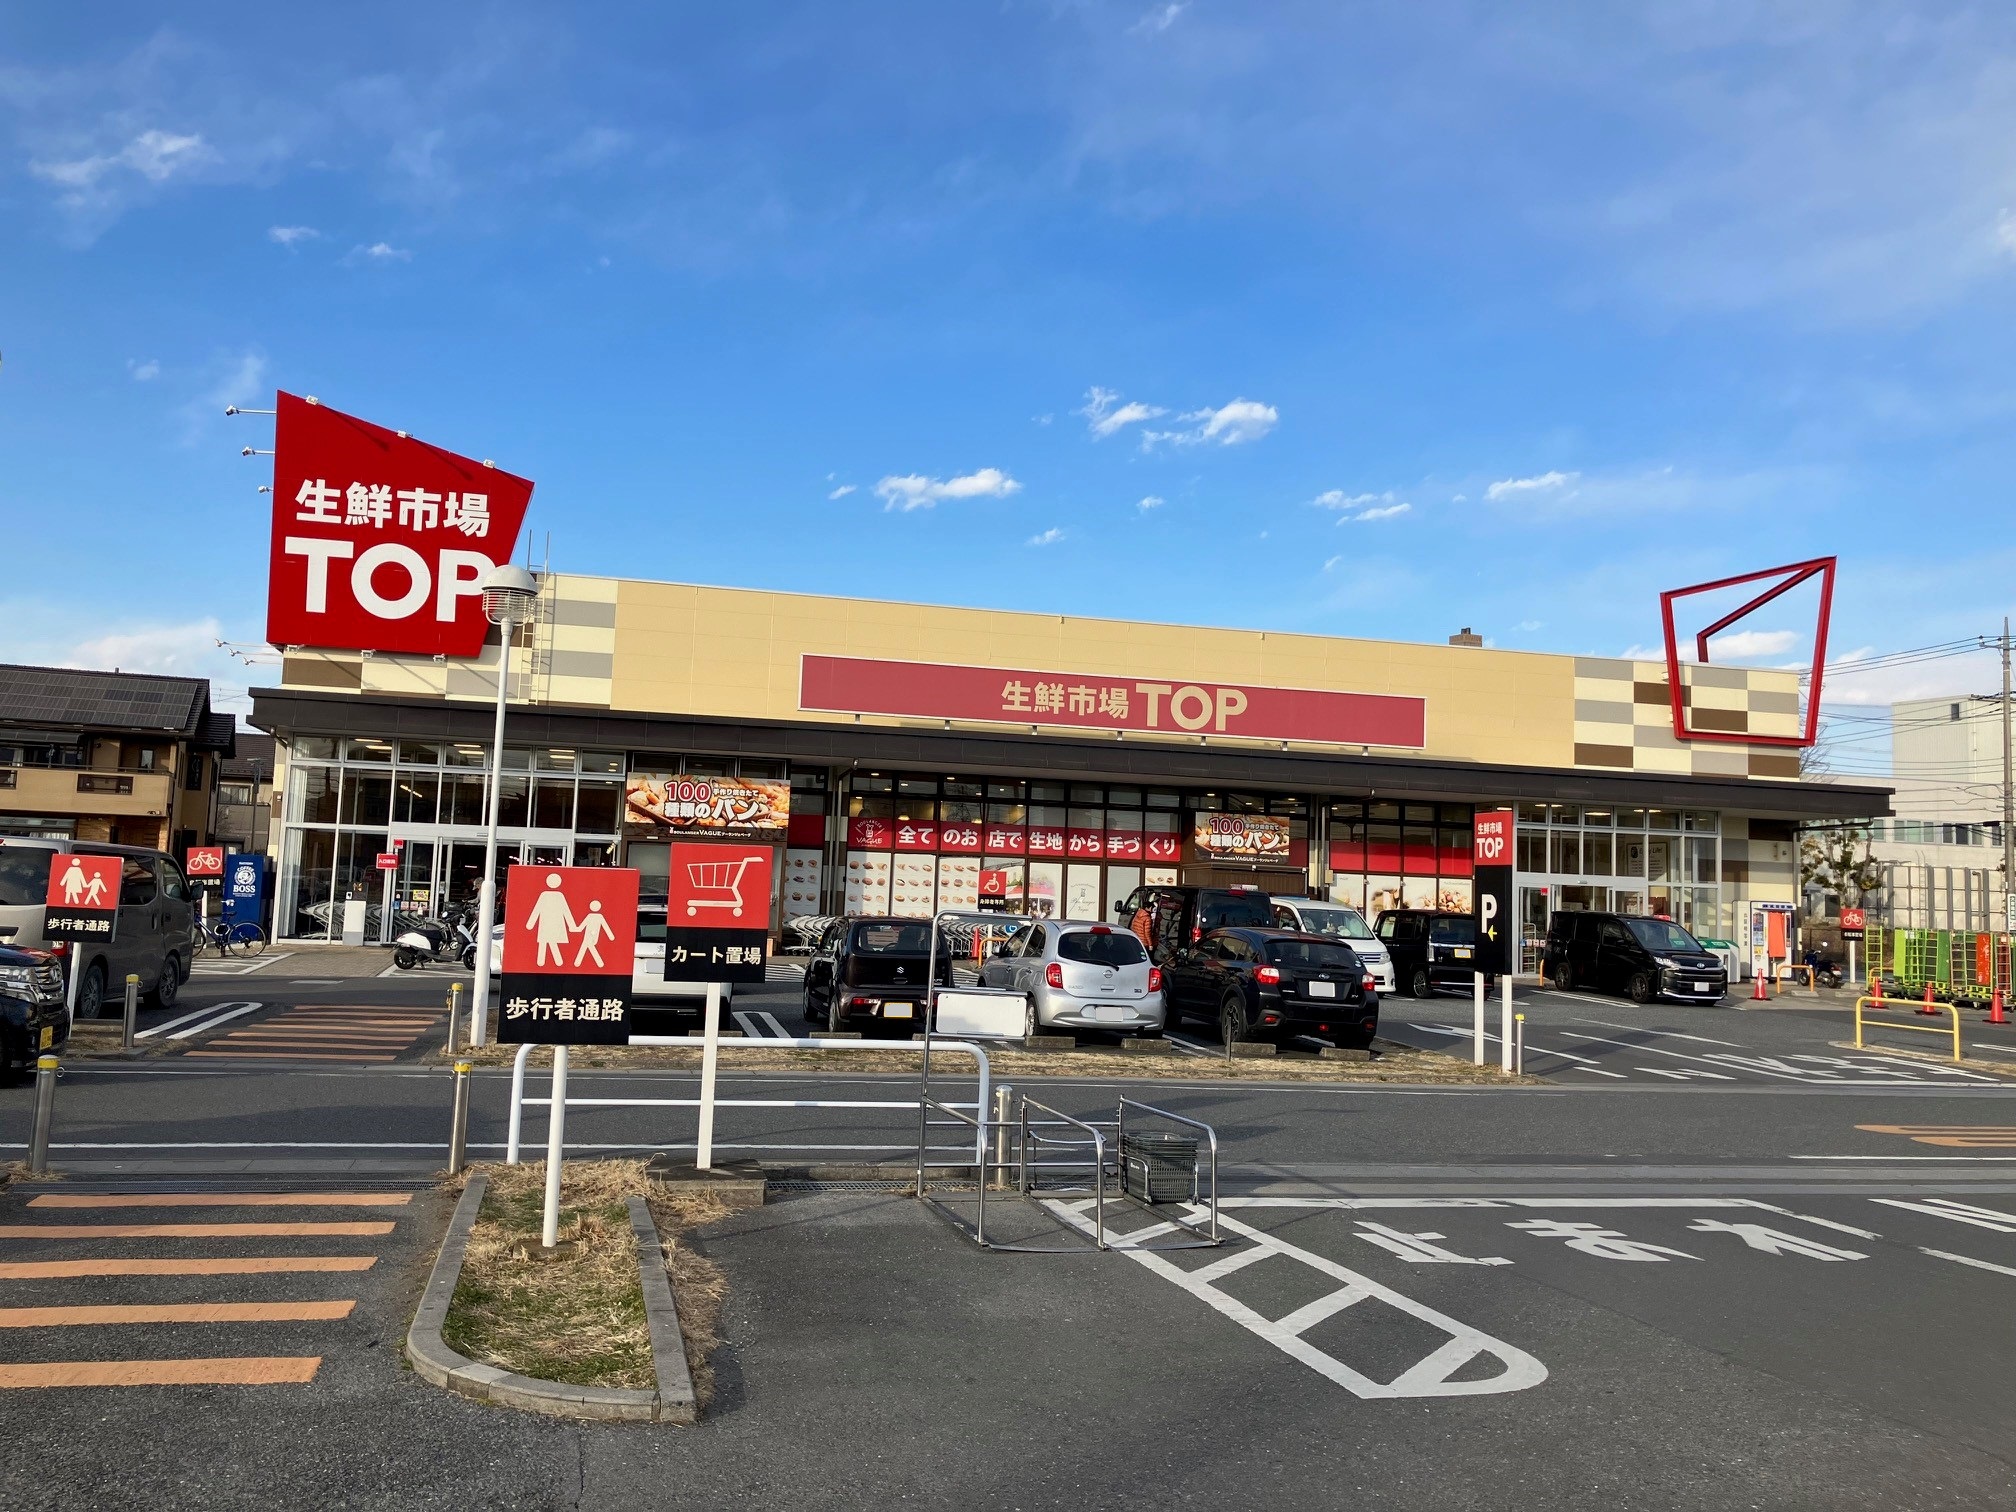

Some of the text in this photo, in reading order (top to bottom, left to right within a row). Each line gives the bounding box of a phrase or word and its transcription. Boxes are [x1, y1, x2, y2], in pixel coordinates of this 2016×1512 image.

[295, 479, 490, 538] 生鮮市場
[285, 536, 496, 623] TOP
[1001, 681, 1248, 731] 生鮮市場 TOP
[664, 780, 711, 802] 100
[699, 829, 721, 837] VAGUE
[1210, 817, 1244, 835] 100
[1477, 822, 1502, 835] 生鮮市場
[1476, 837, 1503, 859] TOP
[233, 884, 256, 893] BOSS
[47, 917, 111, 932] 歩行者通路
[1481, 894, 1498, 934] P
[671, 946, 762, 965] カート置場
[506, 996, 624, 1022] 歩行者通路
[1352, 1217, 1872, 1266] 止まれ
